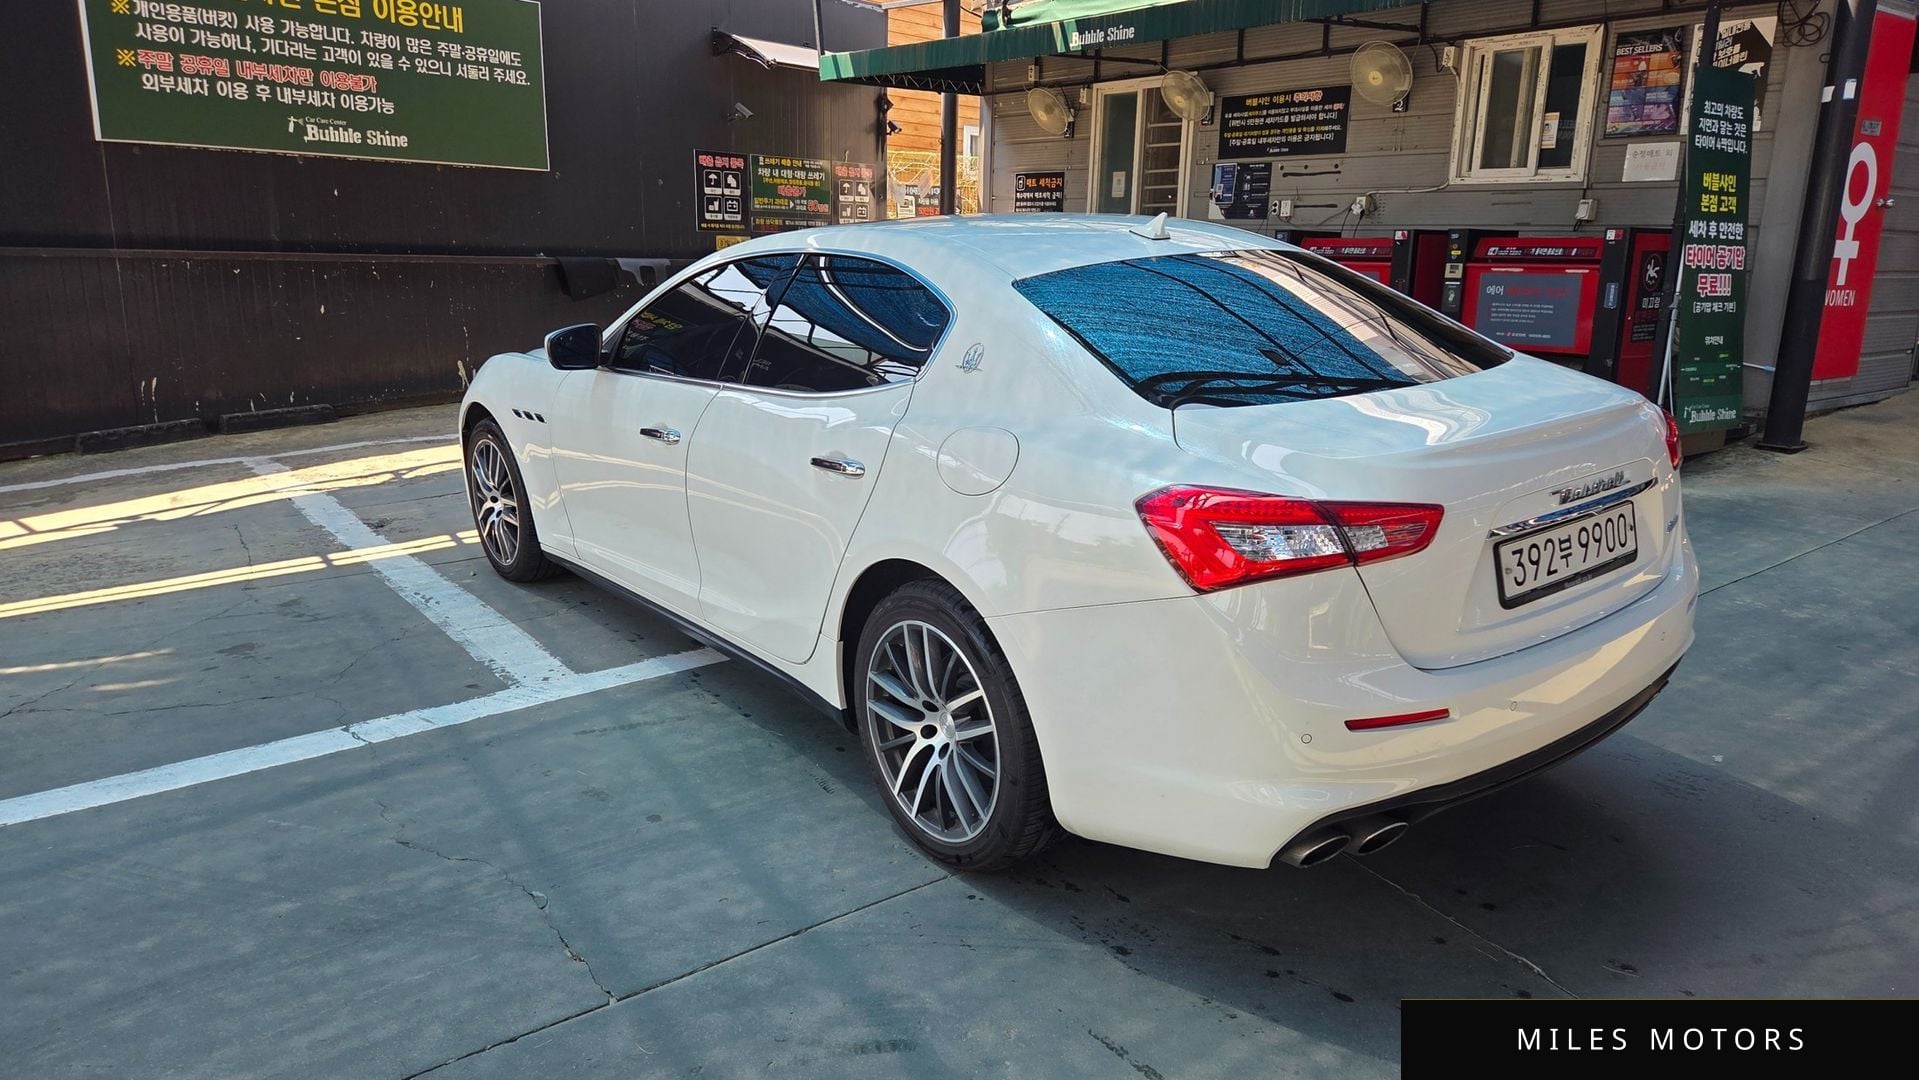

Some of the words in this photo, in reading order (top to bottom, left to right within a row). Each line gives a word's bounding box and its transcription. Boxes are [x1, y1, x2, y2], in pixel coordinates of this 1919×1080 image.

[373, 0, 464, 33] 이용안내
[245, 14, 275, 34] 사용
[280, 19, 355, 45] 가능합니다.
[360, 30, 400, 51] 차량이
[406, 37, 432, 55] 많은
[1070, 29, 1104, 47] Bubble
[1107, 24, 1135, 41] Shine
[135, 22, 185, 44] 사용이
[191, 28, 257, 54] 가능하나,
[261, 37, 317, 61] 기다리는
[322, 46, 361, 66] 고객이
[367, 52, 394, 70] 있을
[398, 56, 411, 71] 수
[415, 58, 451, 77] 있으니
[456, 64, 489, 81] 서둘러
[493, 68, 531, 86] 주세요.
[1616, 46, 1633, 55] BEST
[1633, 44, 1663, 55] SELLERS
[179, 54, 230, 77] 공휴일
[235, 60, 313, 86] 내부세차만
[320, 70, 377, 93] 이용불가
[142, 73, 209, 96] 외부세차
[216, 79, 249, 100] 이용
[255, 84, 272, 102] 후
[276, 87, 336, 109] 내부세차
[340, 93, 395, 114] 이용가능
[1704, 100, 1724, 117] 최고의
[1724, 104, 1744, 120] 차량도
[304, 124, 361, 143] Bubble
[366, 130, 408, 147] Shine
[1698, 117, 1719, 133] 지면과
[1734, 122, 1747, 138] 것은
[1695, 135, 1715, 150] 타이어
[1703, 172, 1737, 192] 버블샤인
[1700, 193, 1718, 213] 본점
[1719, 195, 1737, 214] 고객
[1688, 220, 1707, 238] 세차
[1708, 220, 1718, 239] 후
[1719, 222, 1744, 240] 안전한
[1685, 244, 1716, 269] 타이어
[1717, 245, 1746, 270] 공기압
[1486, 284, 1504, 296] 에어
[1697, 273, 1732, 298] 무료!!!
